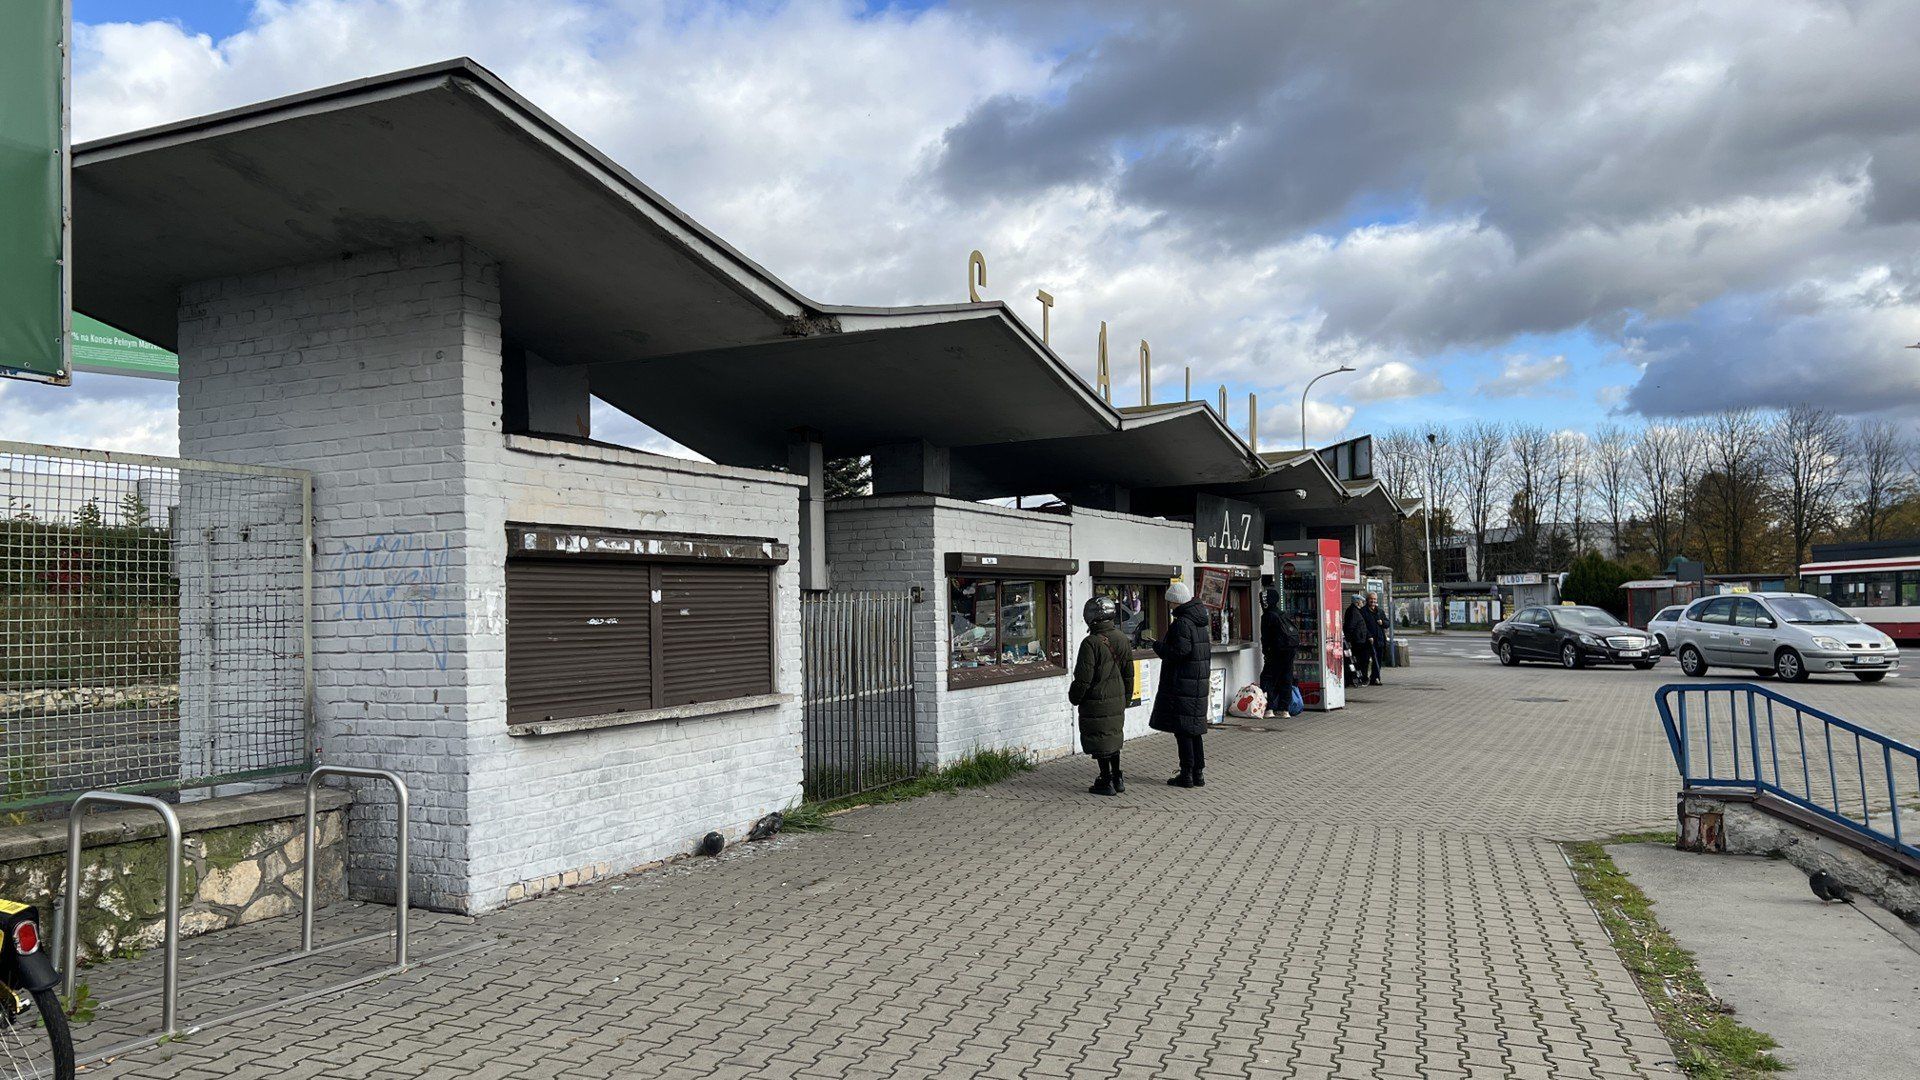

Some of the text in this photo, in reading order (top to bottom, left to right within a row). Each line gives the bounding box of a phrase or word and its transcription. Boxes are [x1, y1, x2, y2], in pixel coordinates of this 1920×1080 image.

[1208, 531, 1217, 548] od
[1219, 510, 1232, 549] A
[1241, 513, 1252, 551] Z
